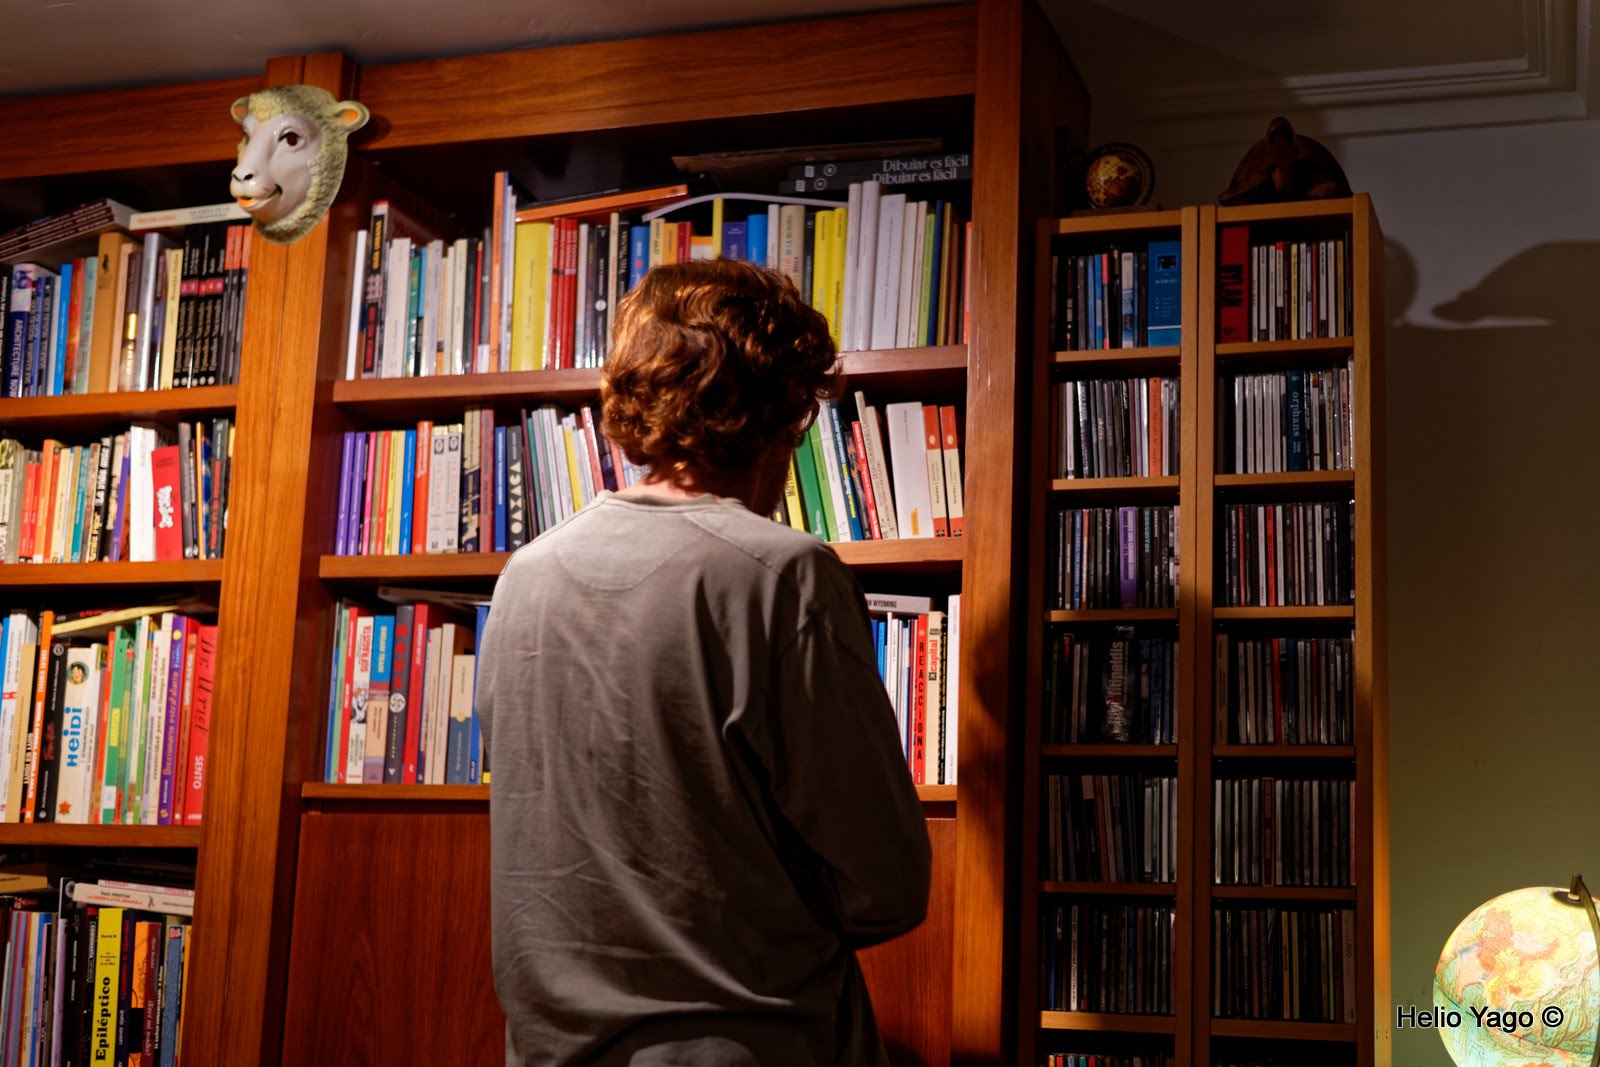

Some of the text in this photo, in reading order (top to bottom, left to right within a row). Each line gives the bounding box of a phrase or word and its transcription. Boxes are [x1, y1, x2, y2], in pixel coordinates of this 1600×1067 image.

[872, 170, 916, 184] Dibujar
[918, 172, 930, 181] es
[882, 154, 968, 171] Dibujar es fácil
[11, 319, 23, 376] ARCHITECTURE
[1290, 391, 1300, 436] orphans
[509, 461, 522, 534] OAXACA
[873, 600, 897, 608] WYOMING
[929, 640, 941, 672] capital
[162, 671, 178, 775] Diccionario estrafalario
[194, 675, 214, 734] Uriel
[916, 642, 924, 760] REACCIONA
[192, 754, 204, 789] SENTO
[95, 976, 110, 1061] Epiléptico
[143, 1000, 154, 1056] ¿Eres mi madre?
